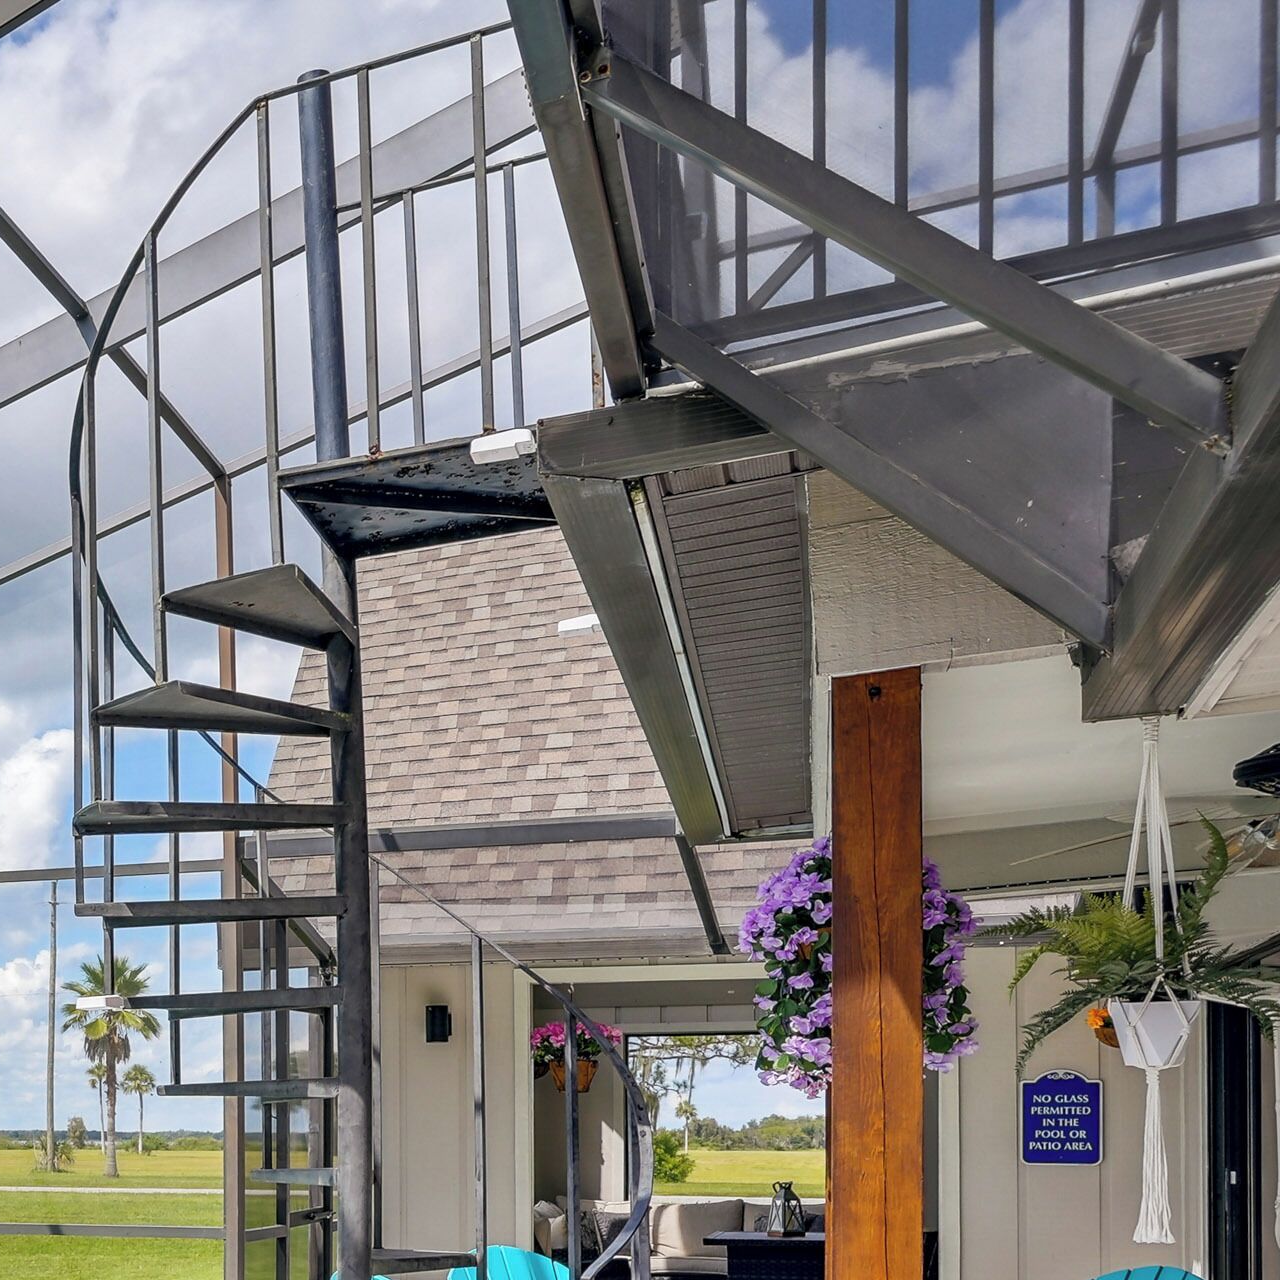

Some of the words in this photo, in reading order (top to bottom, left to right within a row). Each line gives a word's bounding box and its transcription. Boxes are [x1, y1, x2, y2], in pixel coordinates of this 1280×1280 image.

[1032, 1094, 1051, 1103] NO
[1055, 1094, 1089, 1103] GLASS
[1031, 1106, 1091, 1115] PERMITTED
[1042, 1118, 1055, 1127] IN
[1057, 1118, 1079, 1127] THE
[1035, 1130, 1066, 1139] POOL
[1069, 1130, 1087, 1139] OR
[1029, 1142, 1061, 1151] PATIO
[1064, 1142, 1093, 1151] AREA
